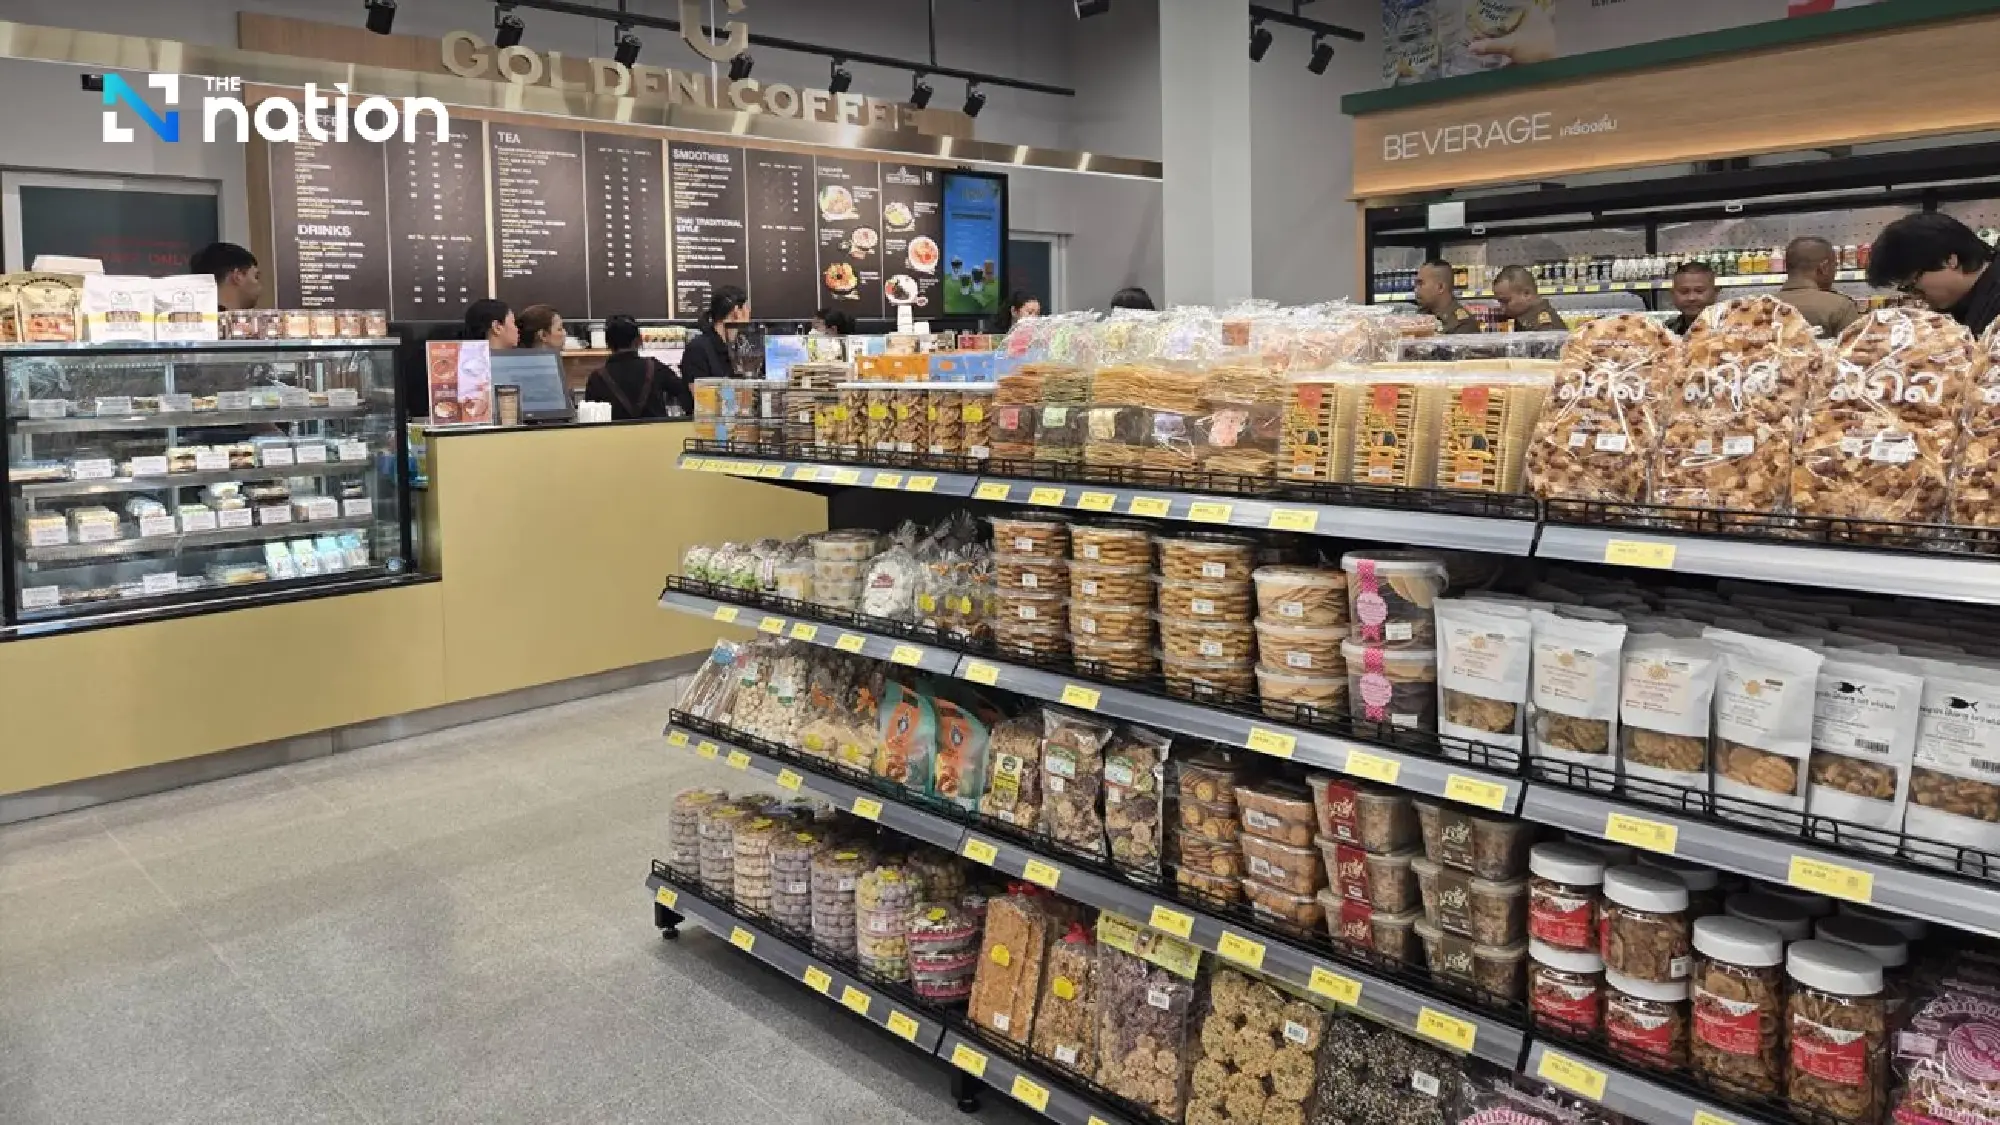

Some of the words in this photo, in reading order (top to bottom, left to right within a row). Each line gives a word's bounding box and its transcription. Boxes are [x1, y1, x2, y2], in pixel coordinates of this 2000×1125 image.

[442, 30, 706, 107] GOLDEN
[728, 77, 918, 136] COFFEE
[497, 131, 521, 144] TEA
[1384, 112, 1552, 162] BEVERAGE
[673, 148, 730, 164] SMOOTHIES
[297, 224, 352, 237] DRINKS
